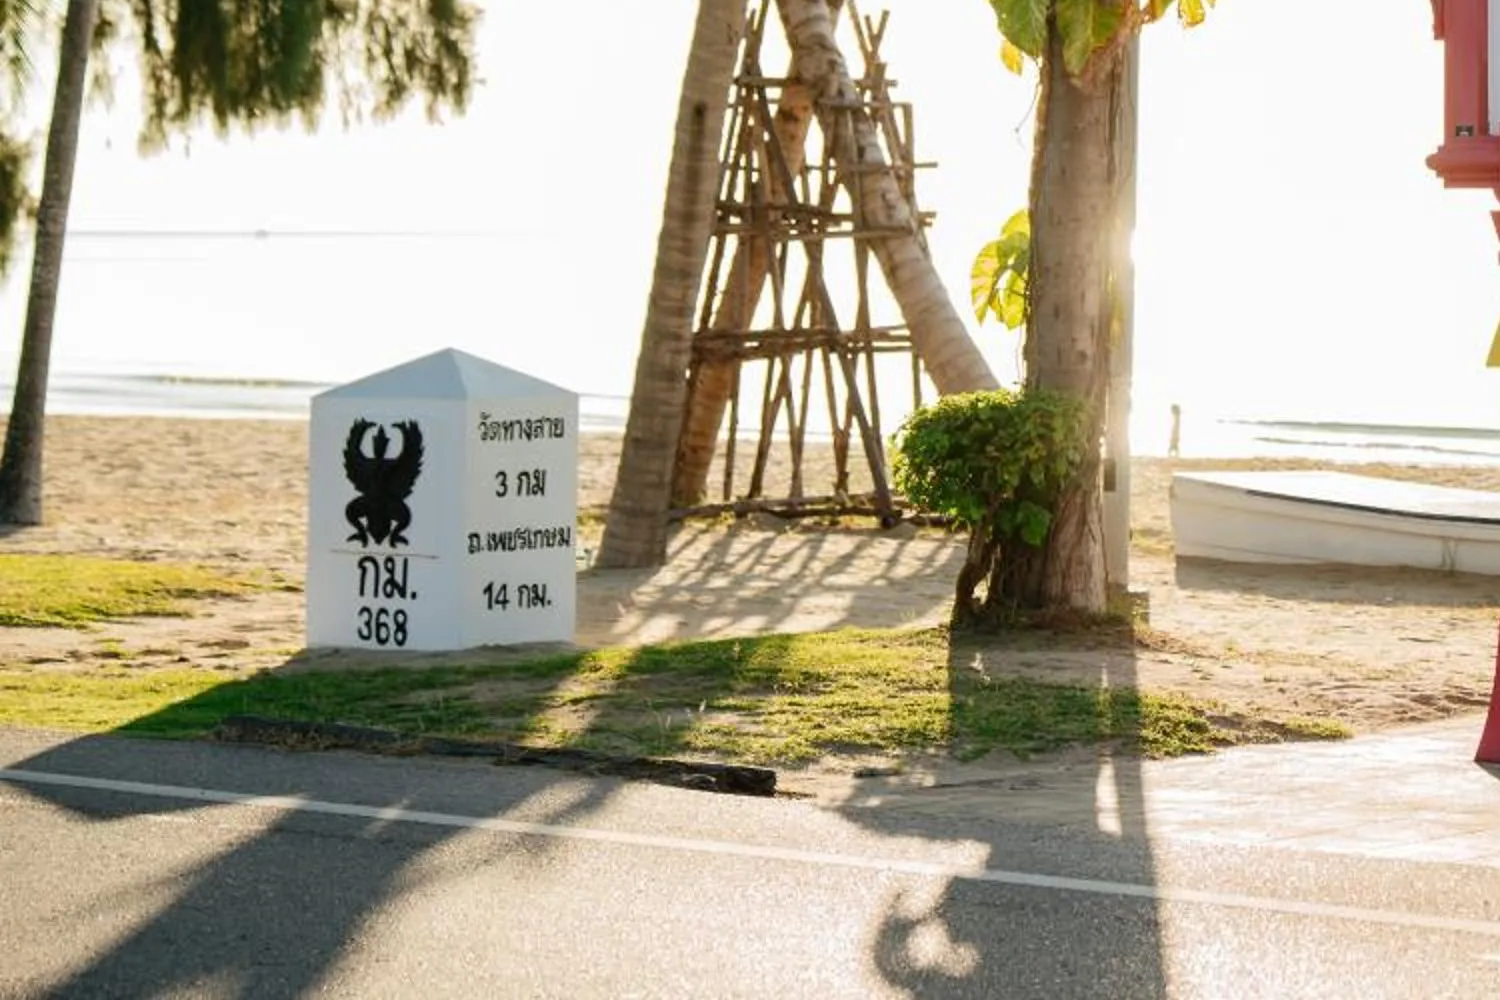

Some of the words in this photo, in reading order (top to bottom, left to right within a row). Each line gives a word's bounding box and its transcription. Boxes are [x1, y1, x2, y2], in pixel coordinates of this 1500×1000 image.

[478, 411, 565, 442] วัดทางสาย
[495, 471, 508, 497] 3
[517, 469, 546, 496] กม
[357, 555, 417, 600] กม.
[483, 581, 510, 611] 14
[518, 583, 552, 609] กม.
[357, 606, 408, 646] 368
